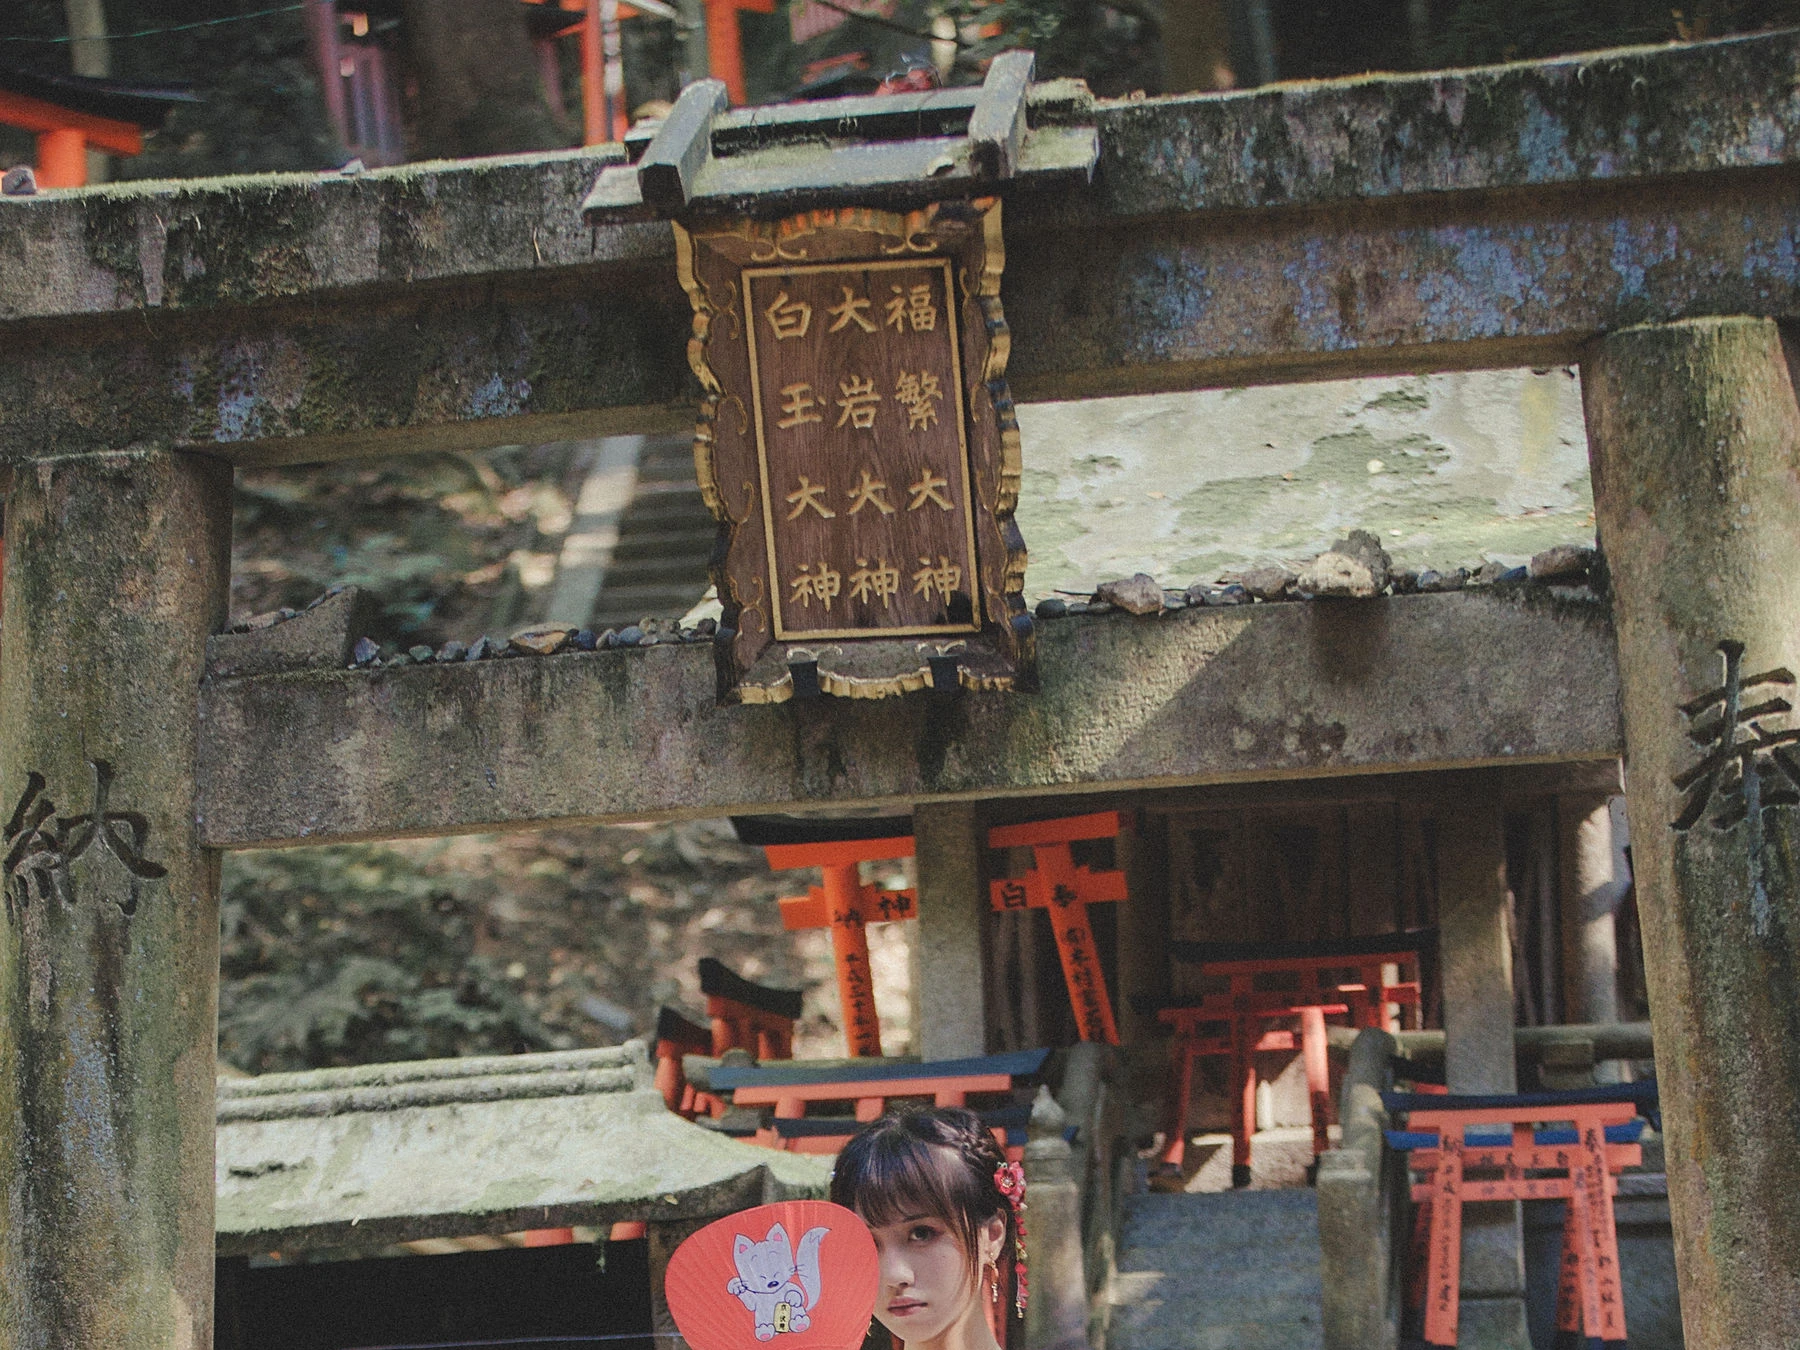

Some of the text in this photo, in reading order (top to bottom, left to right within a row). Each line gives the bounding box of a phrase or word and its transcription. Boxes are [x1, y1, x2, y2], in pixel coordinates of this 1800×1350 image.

[765, 291, 840, 613] 白玉大神
[827, 285, 899, 610] 大岩大神
[887, 284, 962, 606] 福繁大神
